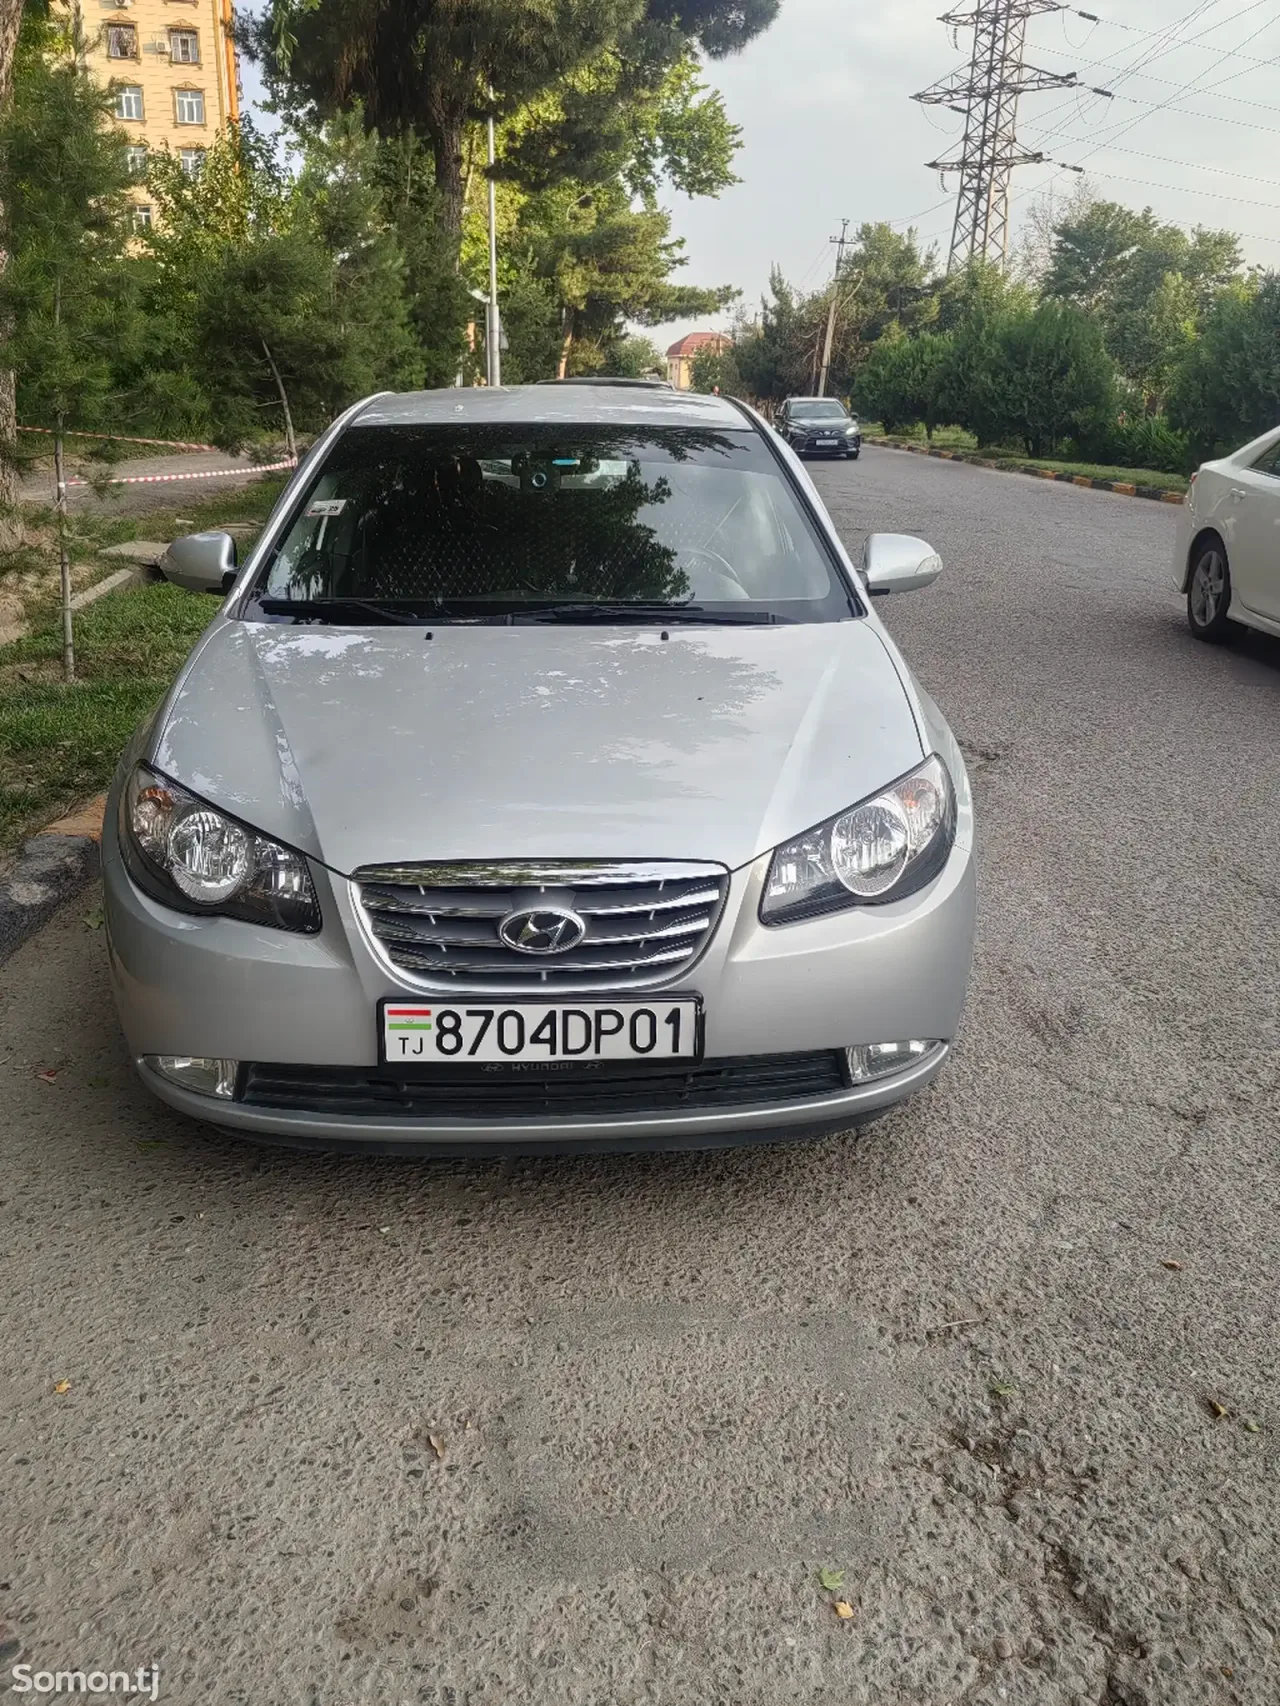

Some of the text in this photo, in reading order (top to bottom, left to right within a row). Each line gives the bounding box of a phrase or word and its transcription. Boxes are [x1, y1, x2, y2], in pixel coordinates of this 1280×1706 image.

[435, 1007, 681, 1056] 8704DP01
[398, 1037, 424, 1055] TJ
[511, 1062, 574, 1072] HYUNDAI
